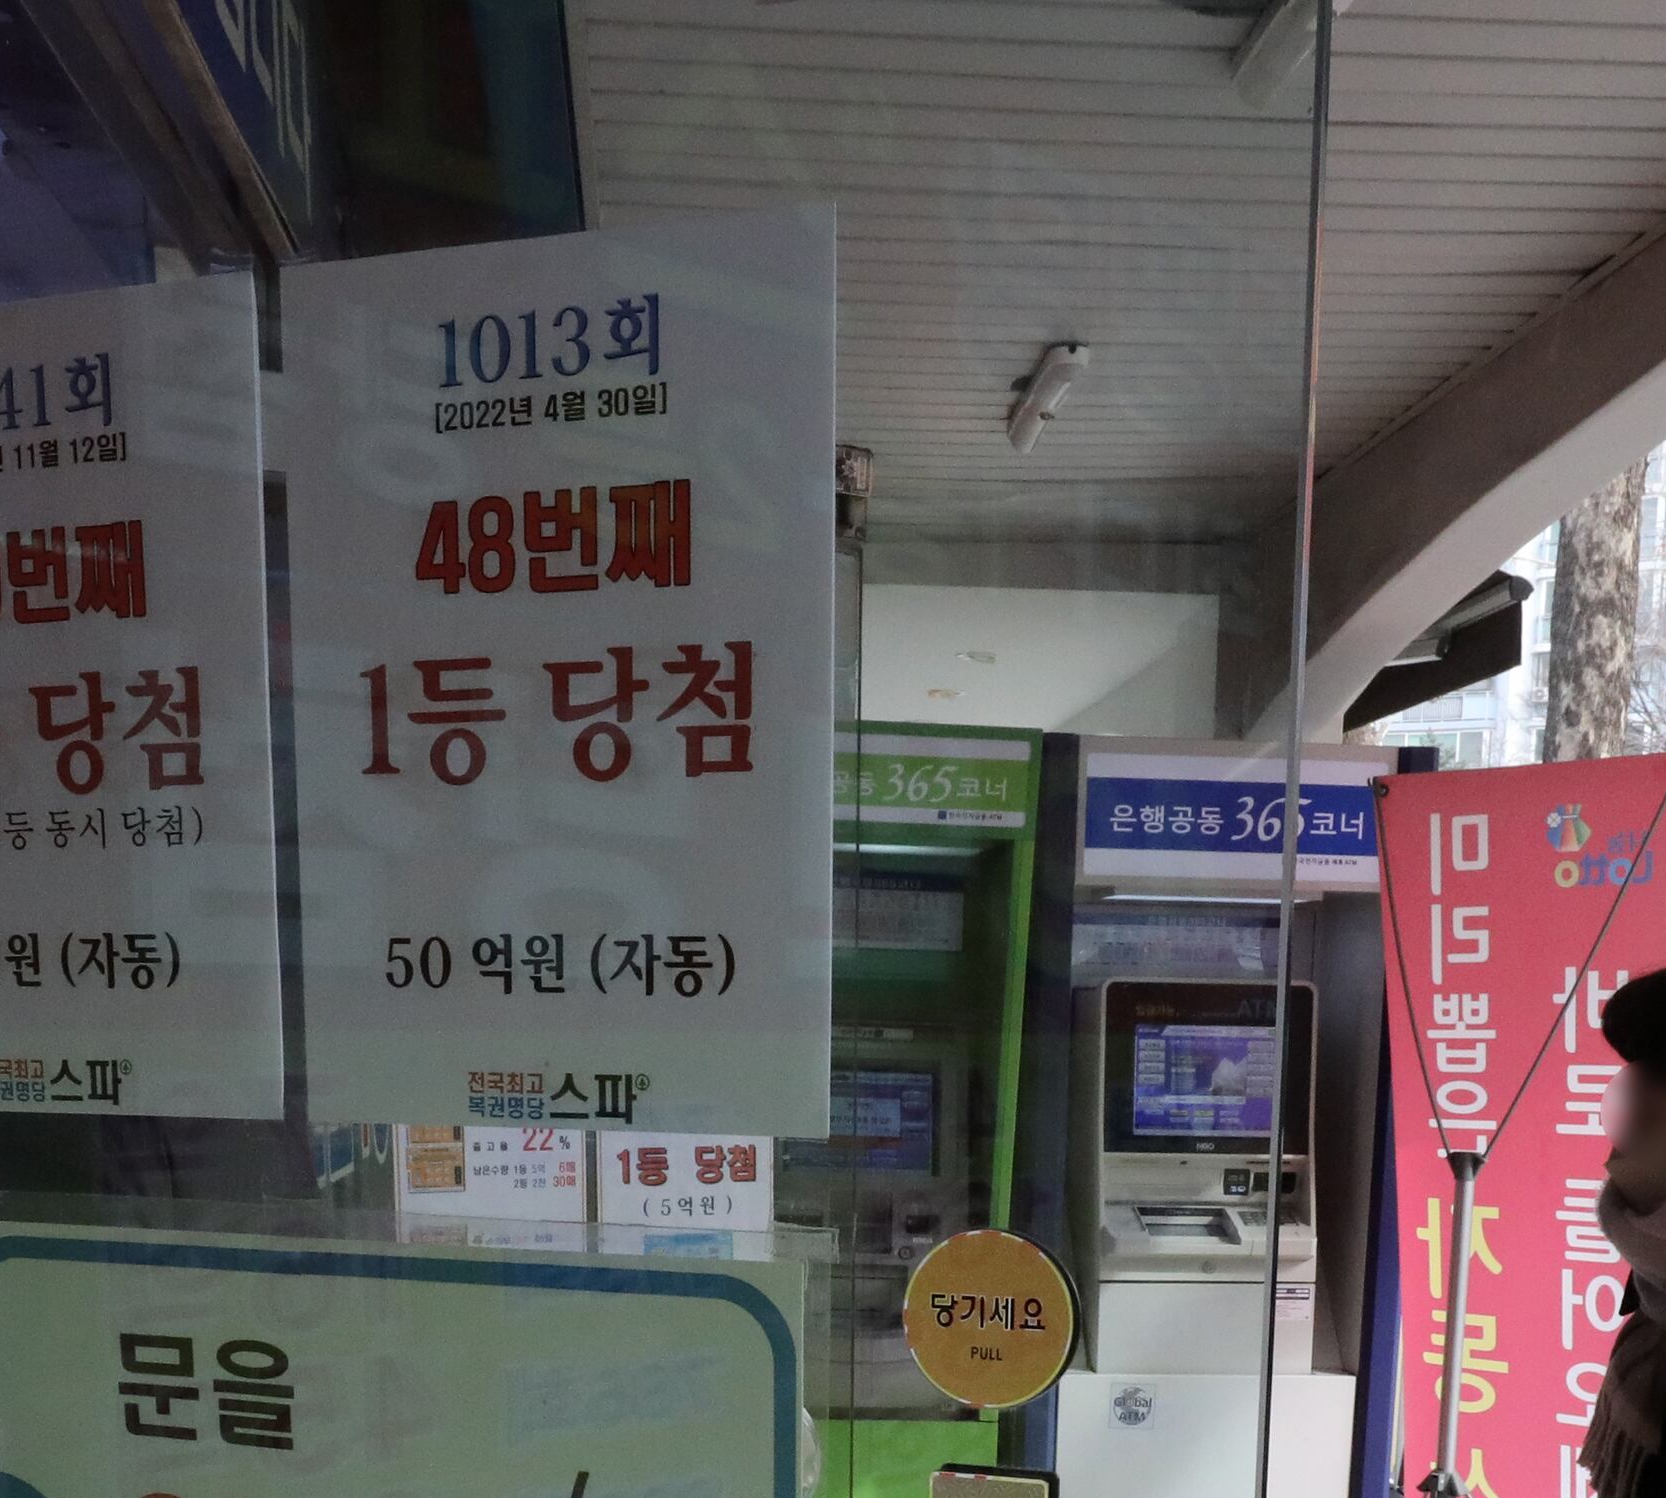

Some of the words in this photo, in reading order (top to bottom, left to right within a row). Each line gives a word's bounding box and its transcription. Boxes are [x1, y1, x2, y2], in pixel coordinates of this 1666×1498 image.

[437, 292, 661, 389] 1013회
[435, 394, 534, 434] [2022년
[543, 390, 587, 423] 4월
[597, 383, 669, 417] 30일]
[14, 439, 59, 471] 11월
[68, 432, 128, 466] 12일]
[415, 479, 692, 594] 48번째
[28, 666, 205, 795] 당첨
[360, 656, 507, 786] 1등
[542, 640, 755, 782] 당첨
[45, 806, 108, 849] 동시
[120, 803, 204, 847] 당첨)
[1109, 803, 1225, 835] 은행공동
[60, 931, 181, 990] (자동)
[385, 936, 452, 991] 50
[471, 933, 566, 995] 억원
[591, 932, 736, 998] (자동)
[50, 1059, 122, 1106] 스파
[467, 1071, 544, 1094] 전국최고
[550, 1073, 637, 1125] 스파
[468, 1096, 545, 1120] 복권명당
[616, 1146, 670, 1187] 1등
[694, 1144, 757, 1187] 당첨
[930, 1292, 1046, 1331] 당기세요
[970, 1346, 1003, 1361] PULL
[117, 1332, 295, 1452] 문을
